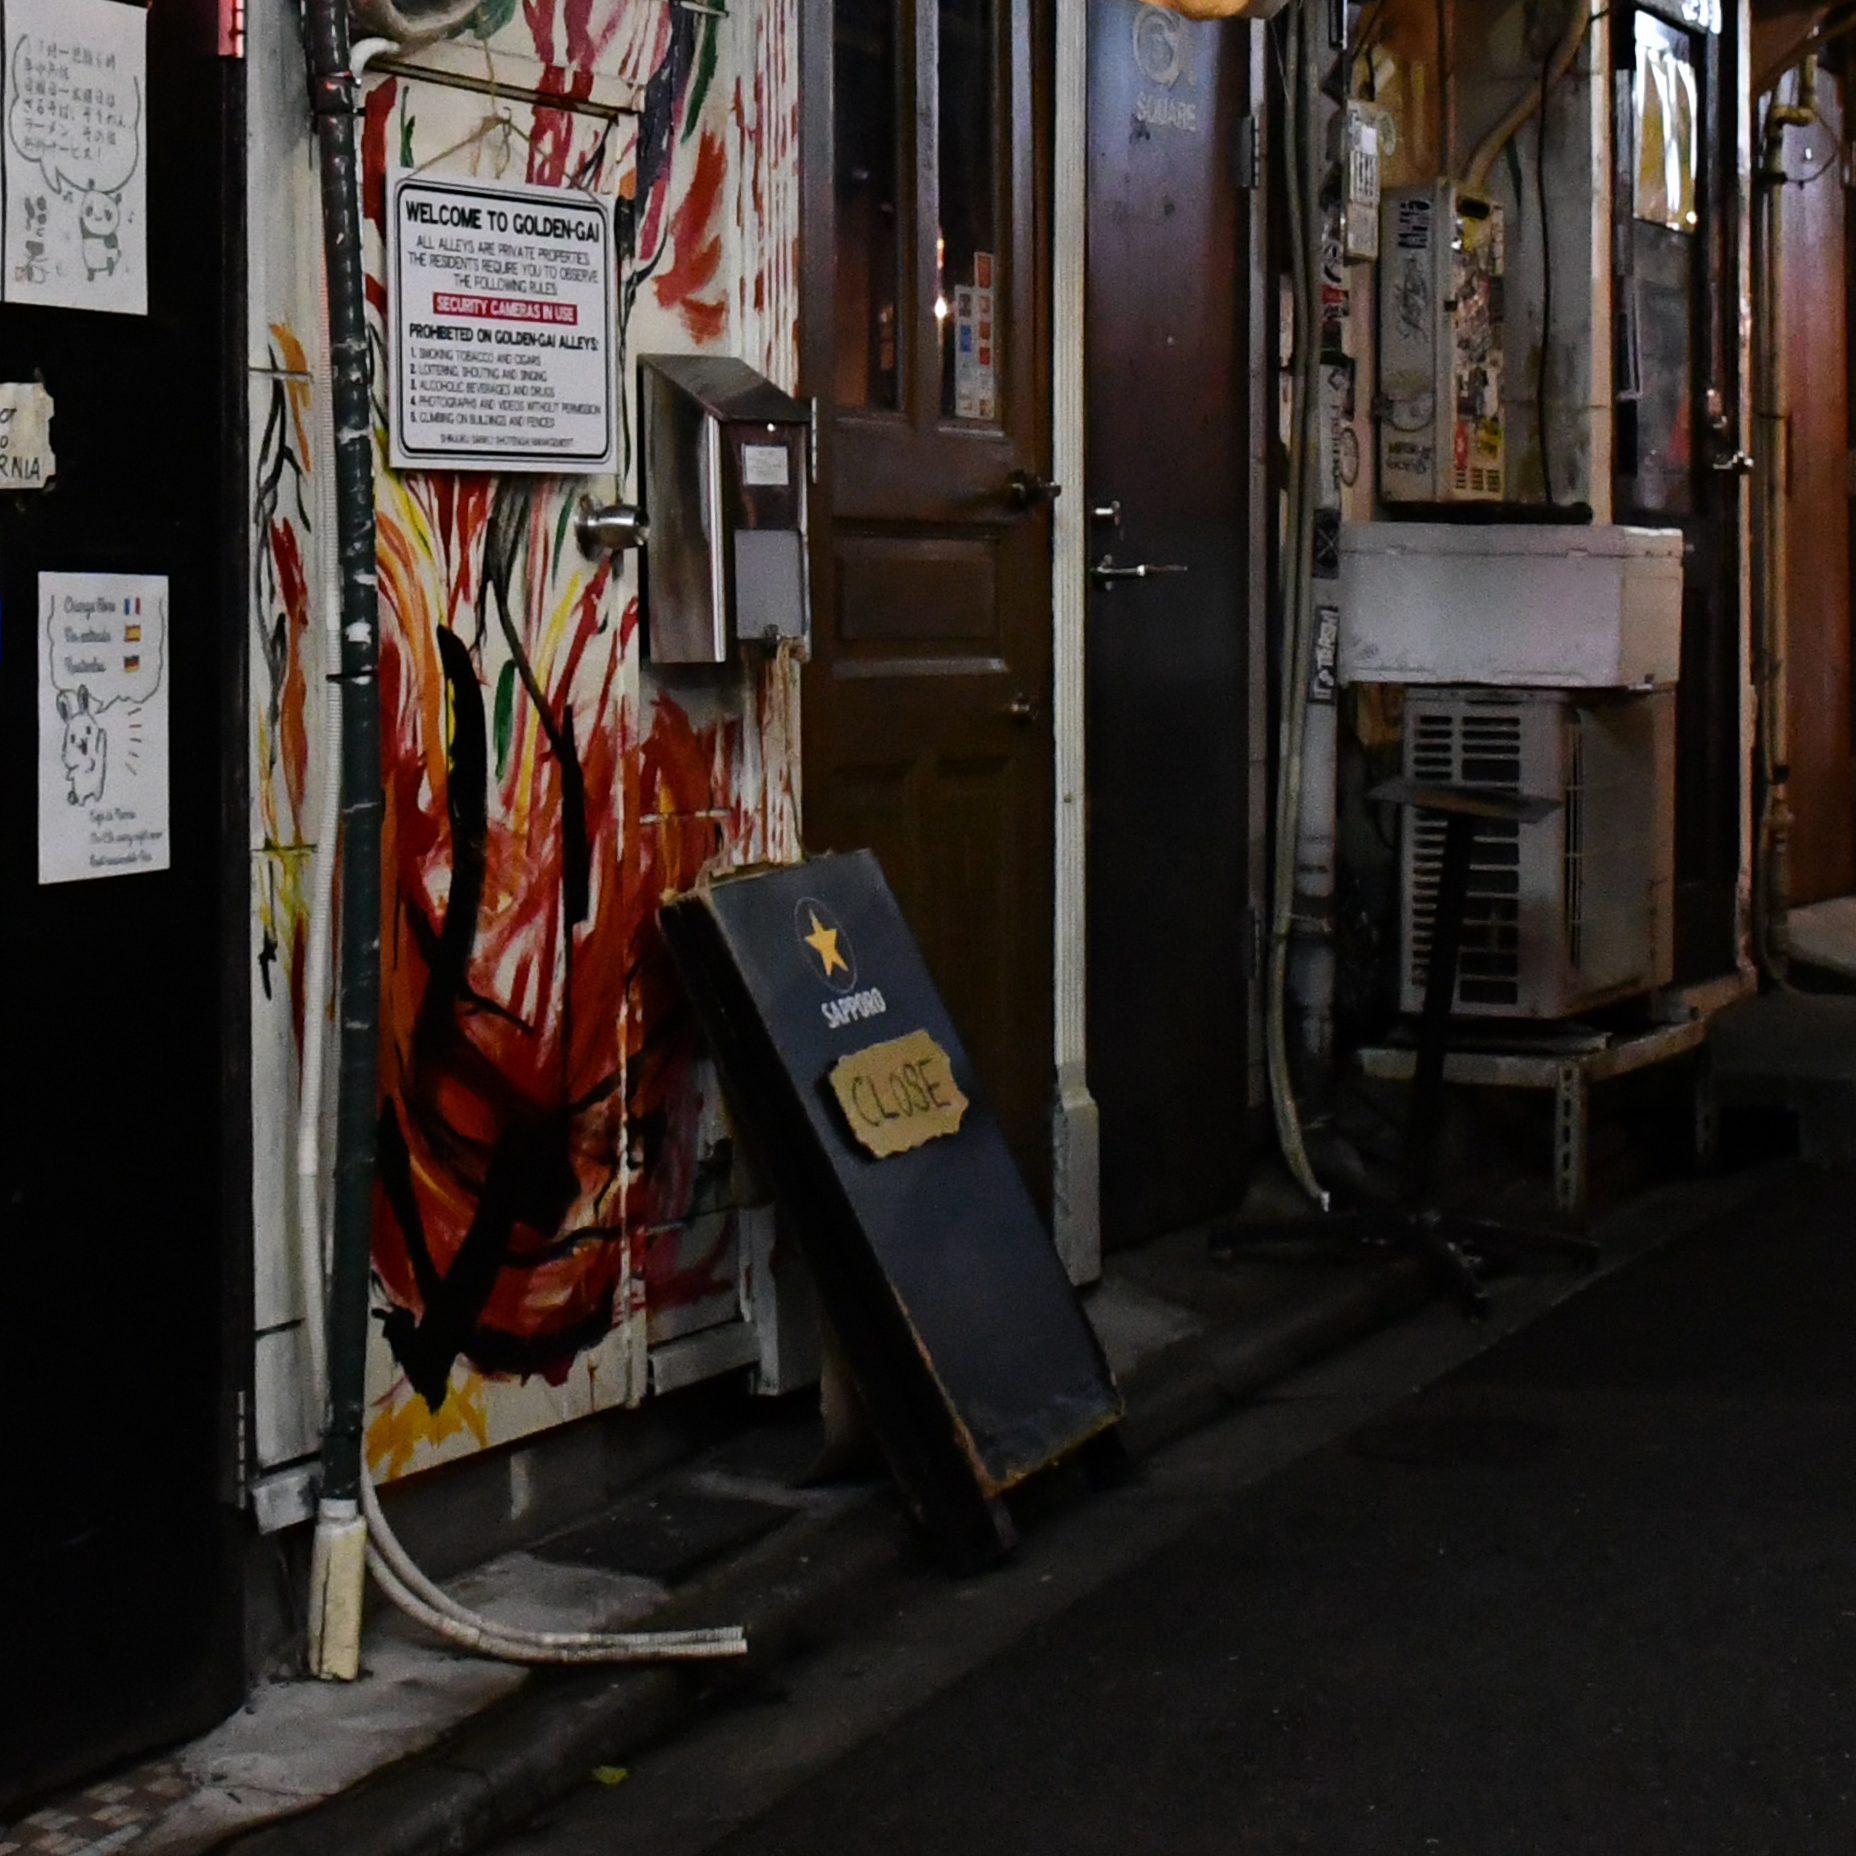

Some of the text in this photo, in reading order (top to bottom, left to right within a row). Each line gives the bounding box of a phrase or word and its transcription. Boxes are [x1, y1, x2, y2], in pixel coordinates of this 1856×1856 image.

[405, 200, 600, 243] WELCOME TO GOLDEN-GAI
[416, 234, 434, 250] ALL
[438, 237, 476, 254] ALLEYS
[478, 241, 496, 256] ARE
[498, 243, 536, 261] PRIVATE
[407, 251, 599, 284] THE RESIDENTS REQUIRE YOU TO OBSERVE
[453, 273, 472, 289] THE
[474, 275, 527, 294] FOLLOWING
[436, 296, 575, 323] SECURITY CAMERAS IN USE
[476, 328, 492, 344] ON
[494, 330, 556, 349] GOLDEN-GAI
[455, 350, 494, 365] TOBACCO
[419, 380, 464, 394] ALCOHOLIC
[466, 382, 511, 396] BEVERAGES
[820, 986, 887, 1029] SAPPORO
[851, 1056, 952, 1129] CLOSE
